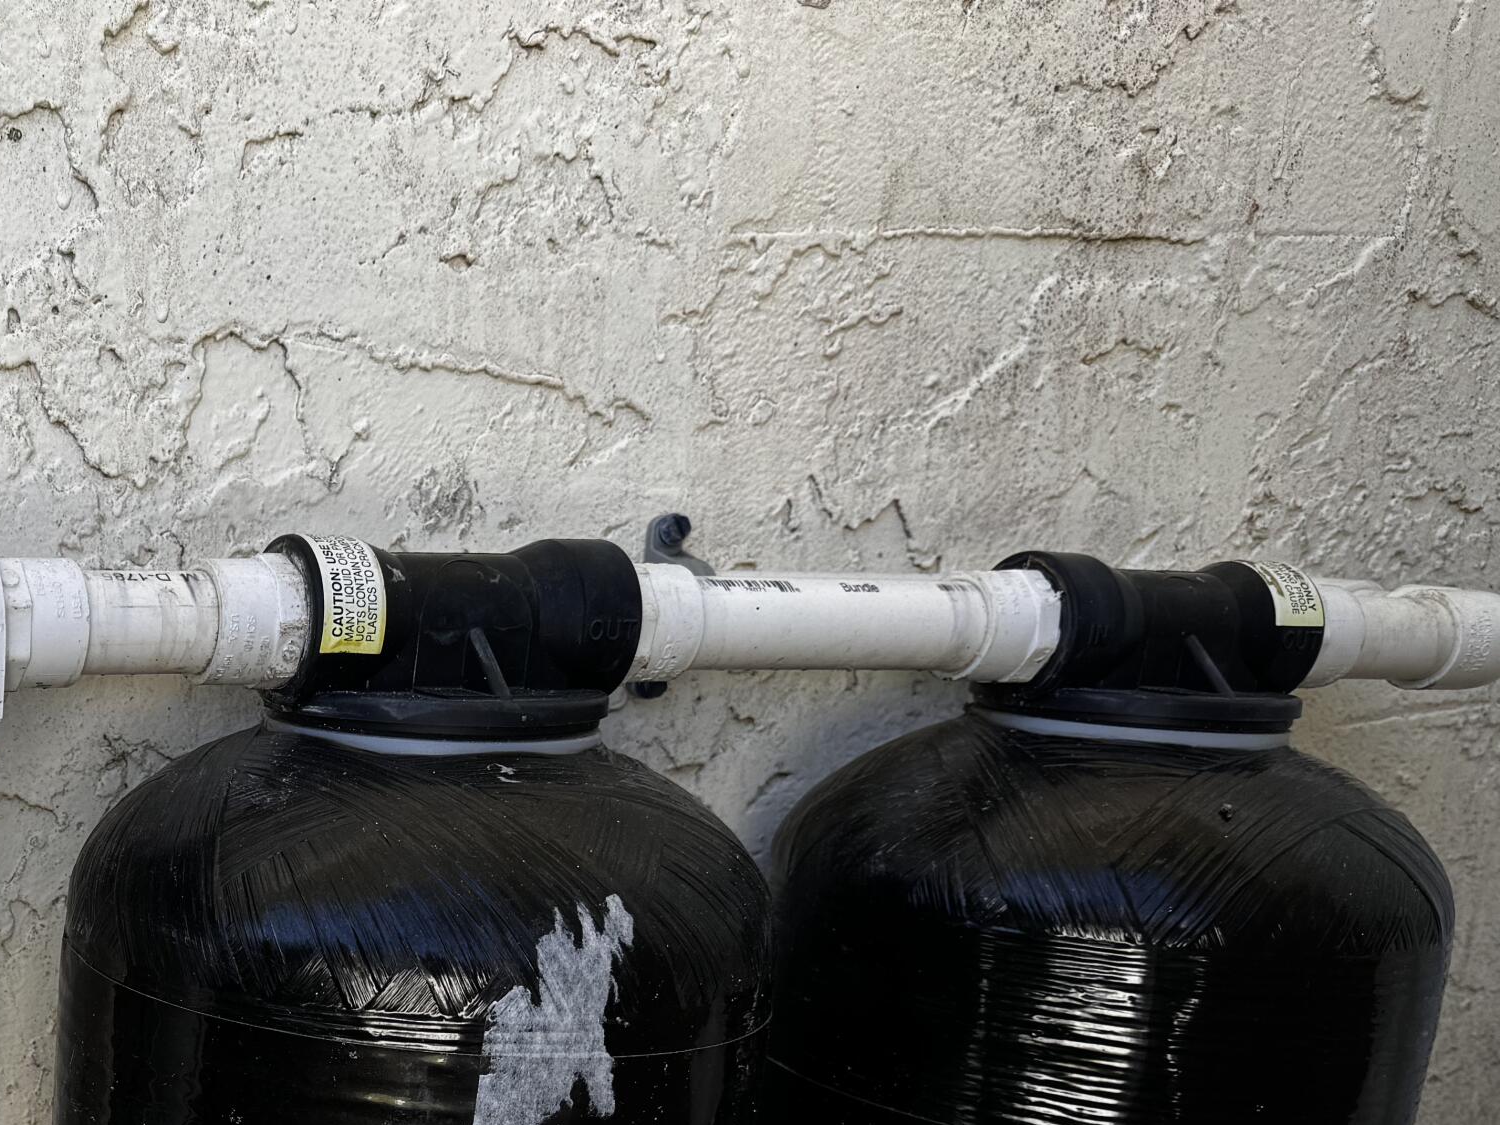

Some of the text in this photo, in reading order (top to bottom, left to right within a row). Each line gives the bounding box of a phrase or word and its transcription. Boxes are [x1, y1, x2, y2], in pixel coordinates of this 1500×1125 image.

[319, 544, 337, 564] USE
[341, 568, 355, 605] LIQUID
[349, 561, 367, 609] CONTAIN
[363, 570, 375, 585] TO
[839, 582, 880, 593] Bundle
[330, 567, 344, 638] CAUTION:
[1284, 584, 1300, 615] CAUSE
[1300, 582, 1317, 612] ONLY
[355, 610, 367, 642] UCTS
[366, 586, 378, 642] PLASTICS
[343, 618, 355, 642] MANY
[589, 619, 639, 640] OUT
[1282, 630, 1322, 650] OUT
